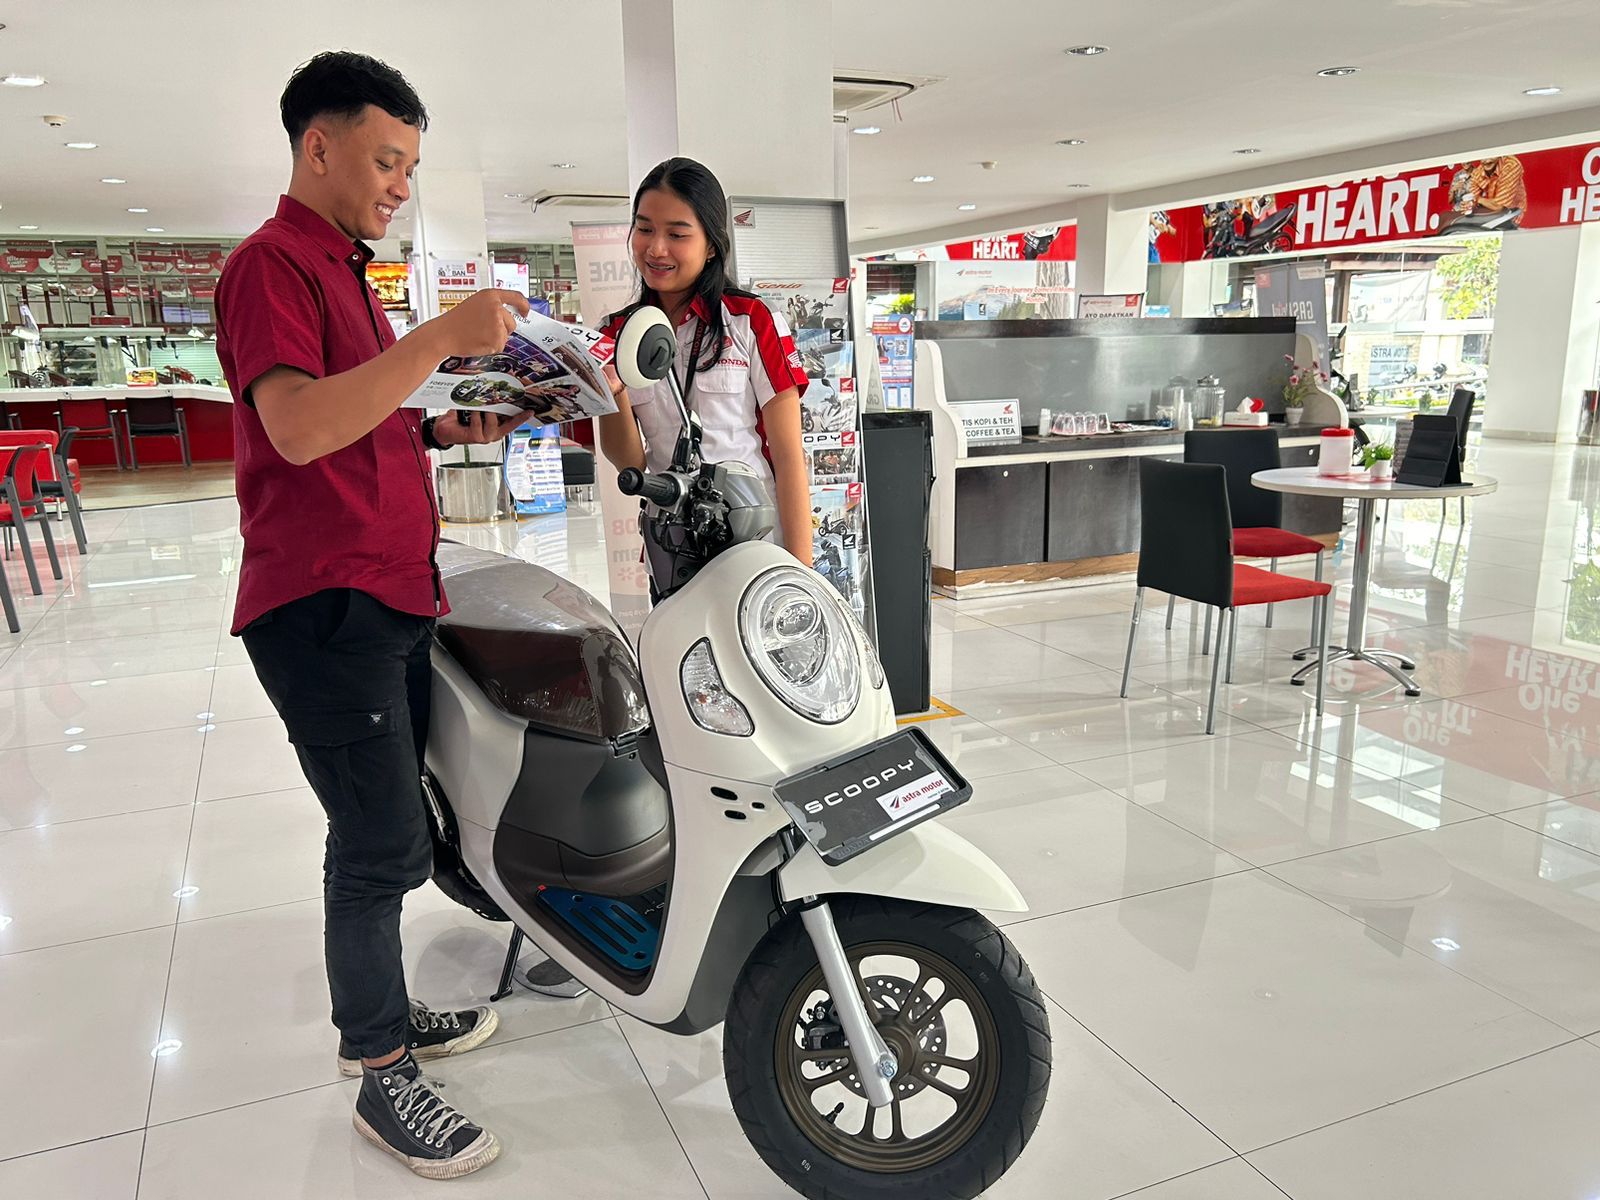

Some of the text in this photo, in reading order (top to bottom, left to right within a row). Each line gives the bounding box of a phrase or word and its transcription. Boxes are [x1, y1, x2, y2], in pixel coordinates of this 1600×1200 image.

[1295, 173, 1440, 245] HEART.
[973, 241, 1019, 259] HEART.
[962, 419, 973, 427] TIS
[974, 418, 991, 426] KOPI
[999, 417, 1013, 425] TEH
[966, 429, 994, 437] COFFEE
[804, 759, 914, 814] SCOOPY
[902, 790, 922, 803] astra
[920, 779, 944, 794] motor
